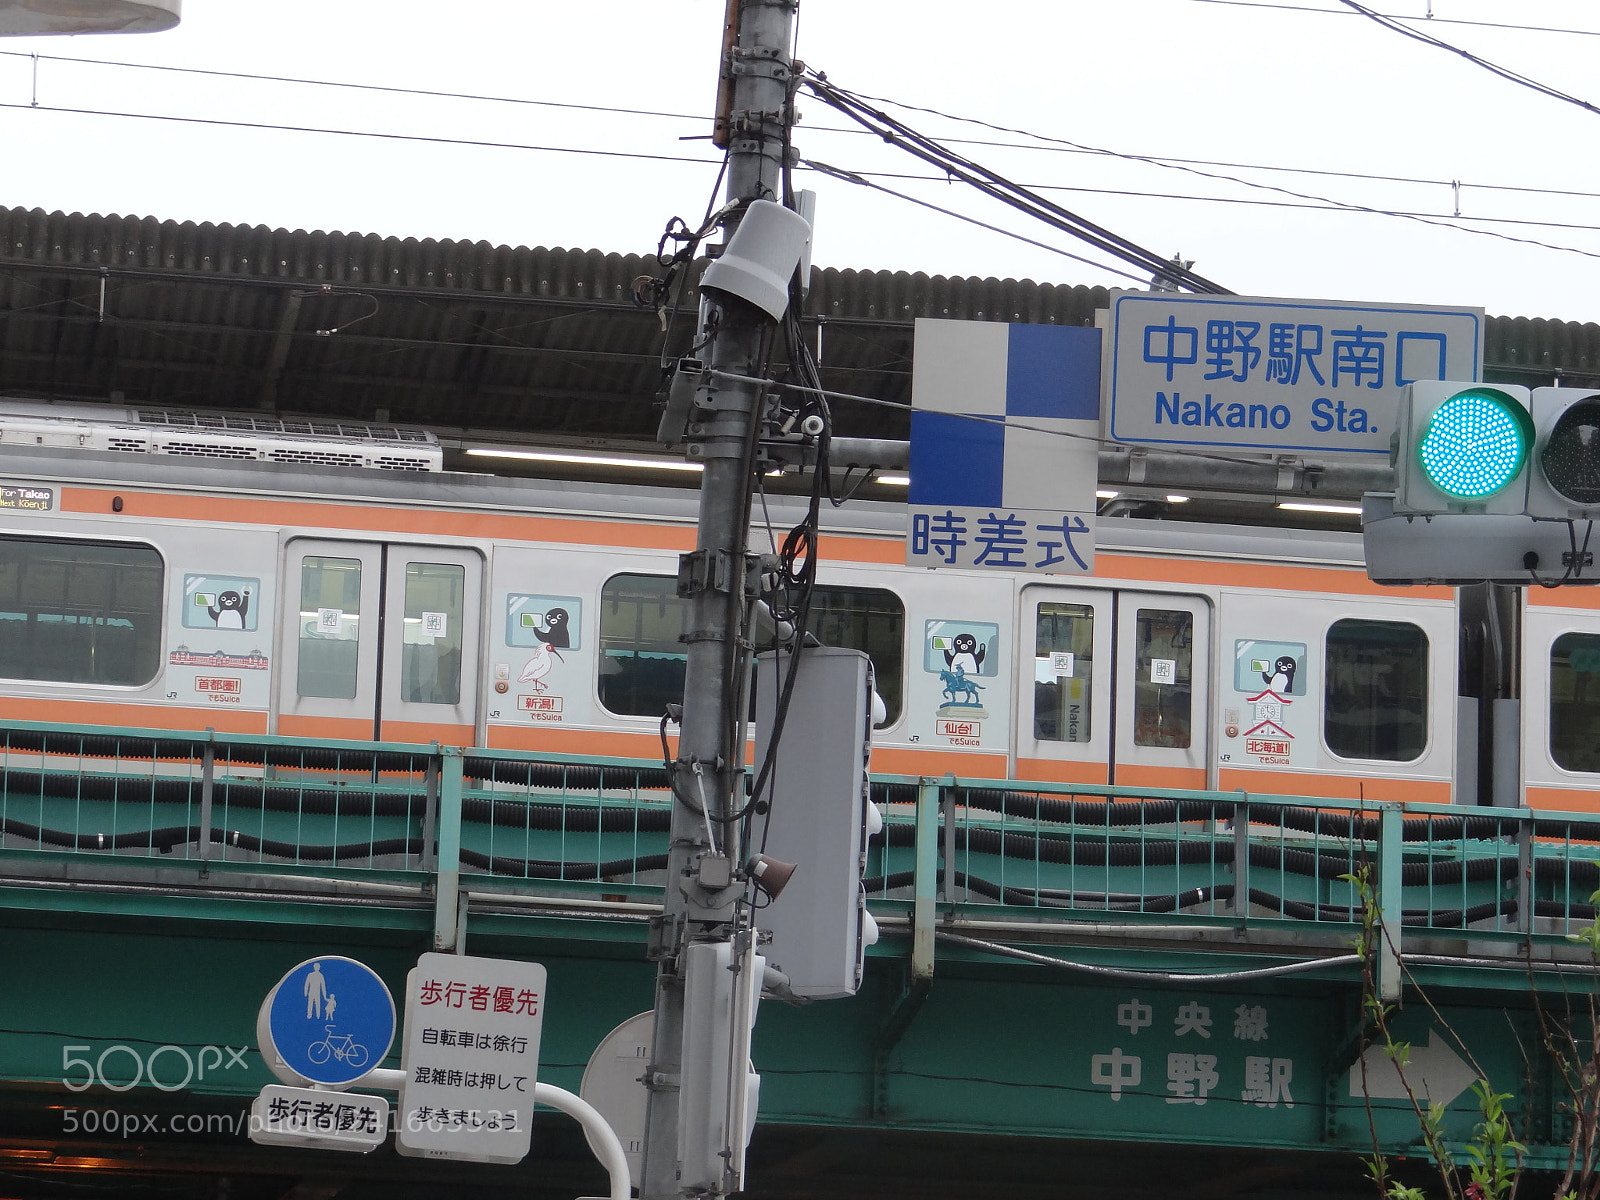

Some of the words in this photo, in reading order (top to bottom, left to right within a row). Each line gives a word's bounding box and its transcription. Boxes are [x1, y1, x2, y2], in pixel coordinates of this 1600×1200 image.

[1143, 314, 1446, 389] 中野駅南口
[1154, 391, 1291, 430] Nakano
[1309, 397, 1378, 434] Sta.
[2, 488, 17, 497] For
[18, 488, 50, 499] Takao
[912, 511, 1090, 570] 時差式
[420, 979, 539, 1016] 歩行者優先
[1117, 998, 1270, 1041] 中央線
[421, 1027, 529, 1055] 自転車は徐行
[414, 1066, 529, 1093] 混雑時は押して
[1091, 1047, 1295, 1109] 中野駅
[268, 1096, 378, 1135] 歩行者優先
[416, 1105, 518, 1131] 歩きましょう
